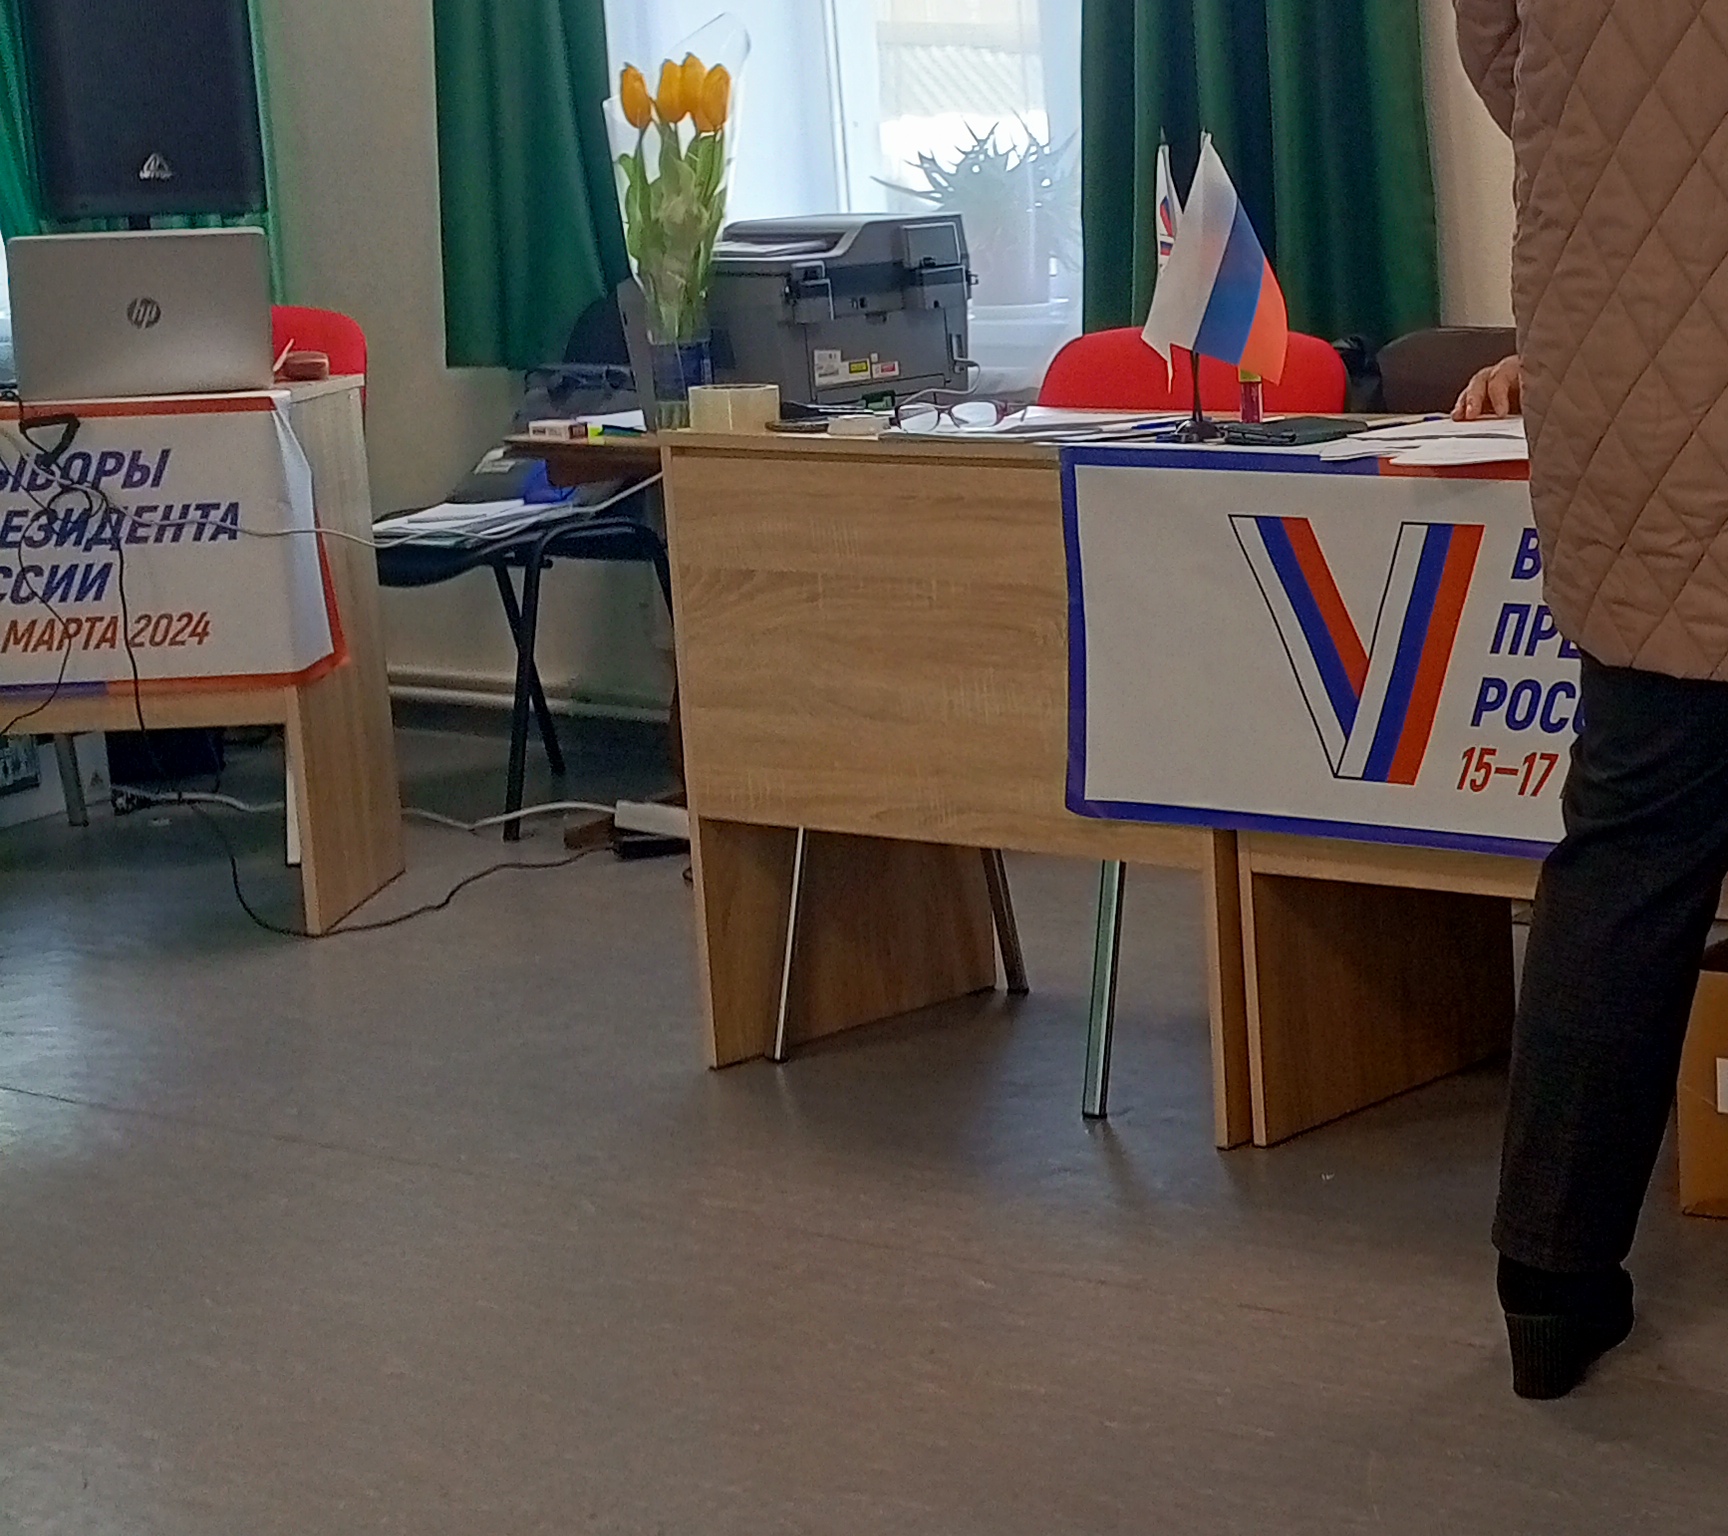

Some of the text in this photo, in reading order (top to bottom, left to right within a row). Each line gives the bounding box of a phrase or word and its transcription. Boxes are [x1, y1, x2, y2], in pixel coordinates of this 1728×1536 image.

[127, 297, 161, 329] hp
[1, 612, 211, 653] МАРТА 2024
[1470, 677, 1587, 734] РОС
